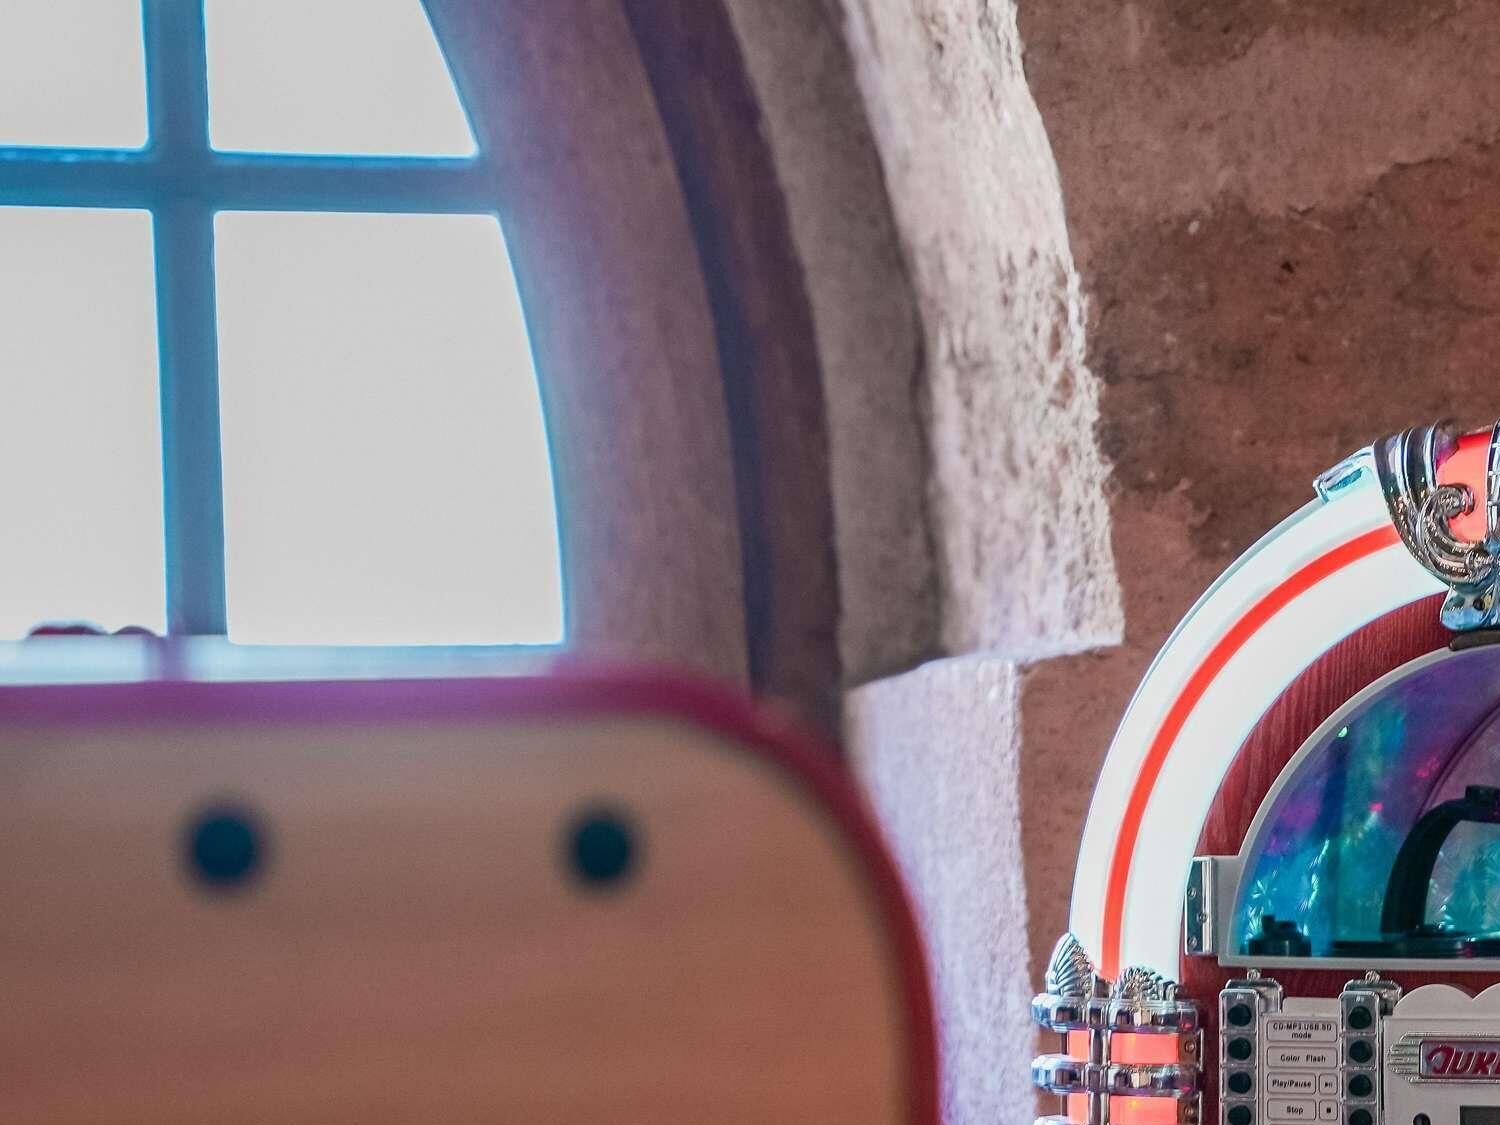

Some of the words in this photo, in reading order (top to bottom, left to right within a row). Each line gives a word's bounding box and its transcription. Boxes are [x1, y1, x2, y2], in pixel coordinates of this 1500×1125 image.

[1280, 1053, 1300, 1063] Color
[1306, 1054, 1326, 1063] Flash
[1272, 1079, 1312, 1090] Play/Pause
[1286, 1106, 1304, 1115] Stop
